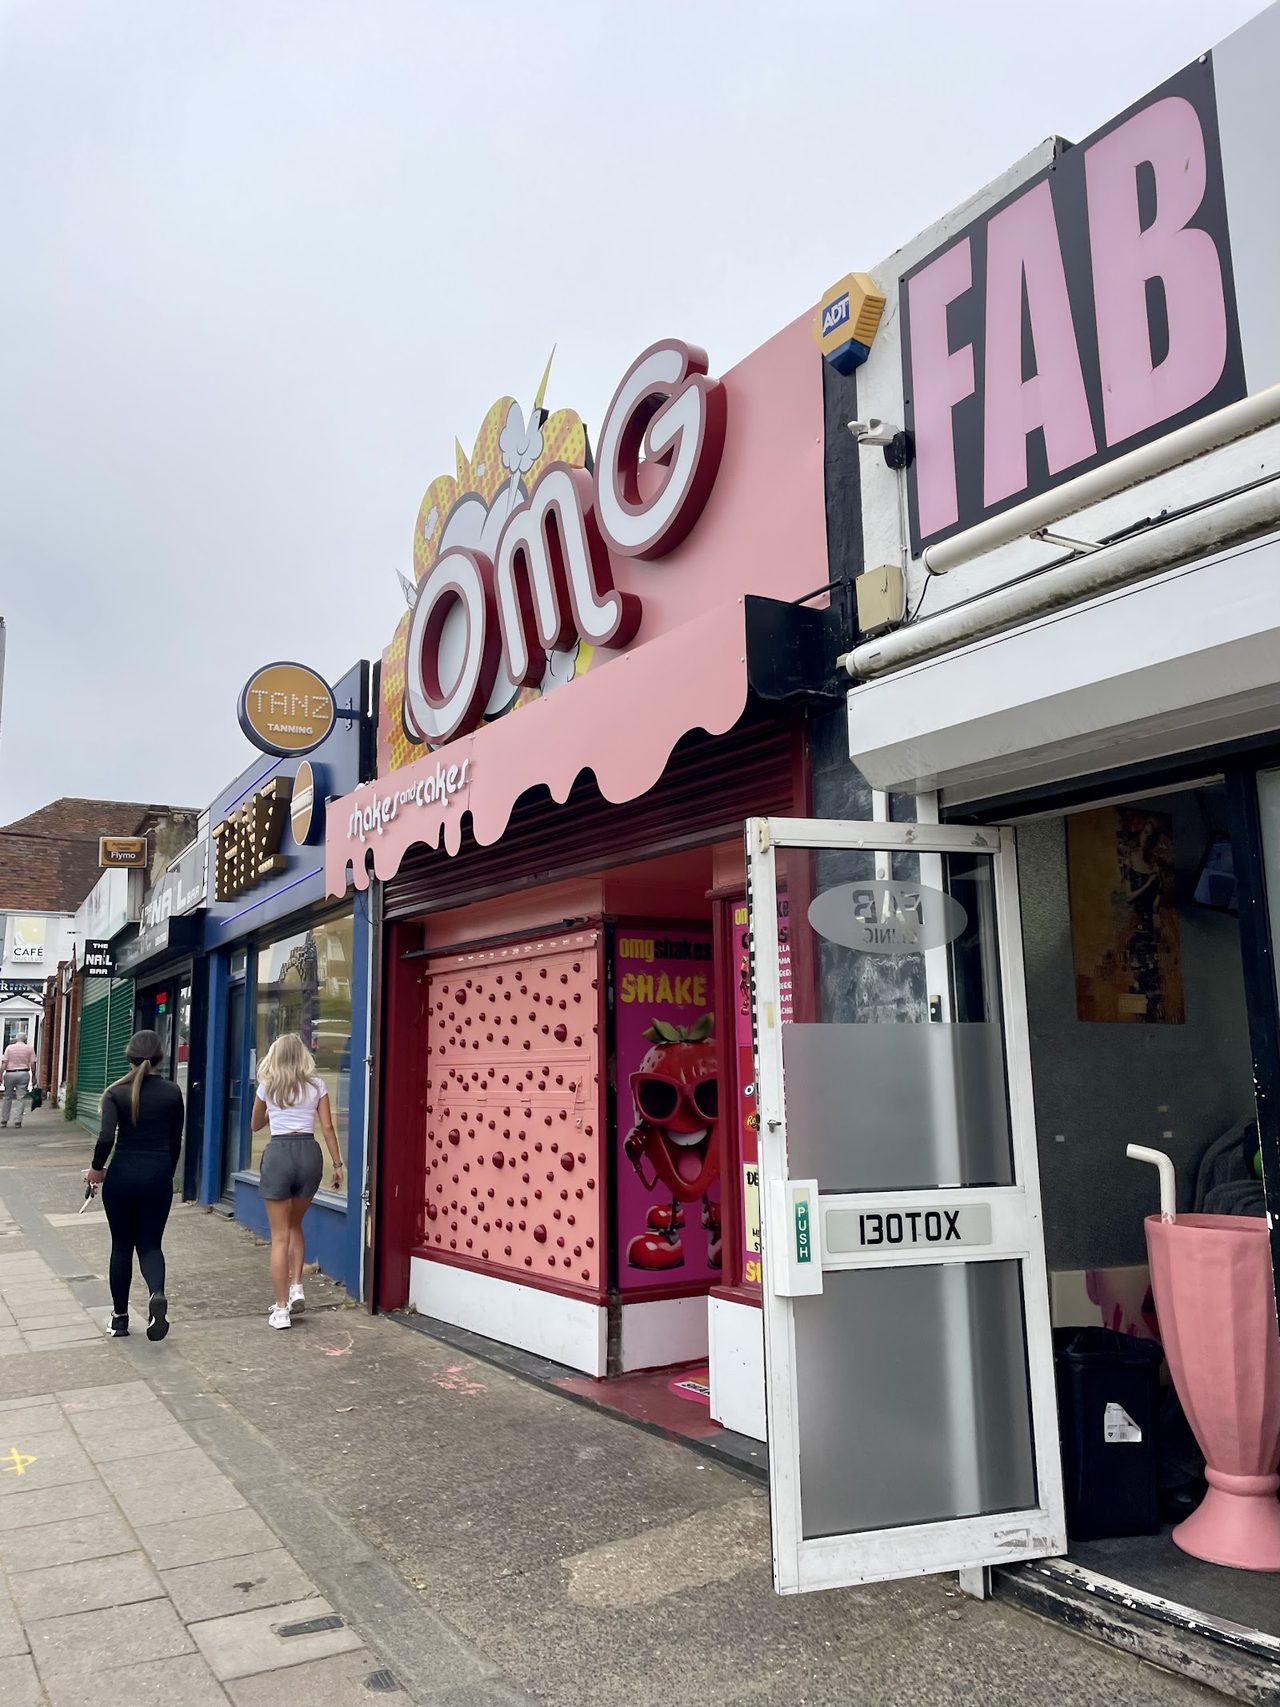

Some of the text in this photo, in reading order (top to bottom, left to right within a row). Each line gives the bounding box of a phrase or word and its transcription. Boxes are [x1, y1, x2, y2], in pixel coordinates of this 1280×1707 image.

[823, 296, 850, 333] ADT
[908, 96, 1228, 540] FAB
[251, 689, 330, 719] TANZ
[267, 723, 313, 735] TANNING
[346, 758, 470, 842] shakes and cakes
[111, 851, 136, 860] Flymo
[13, 946, 44, 956] CAFÉ
[621, 971, 706, 1006] SHAKE
[797, 1206, 809, 1258] PUSH
